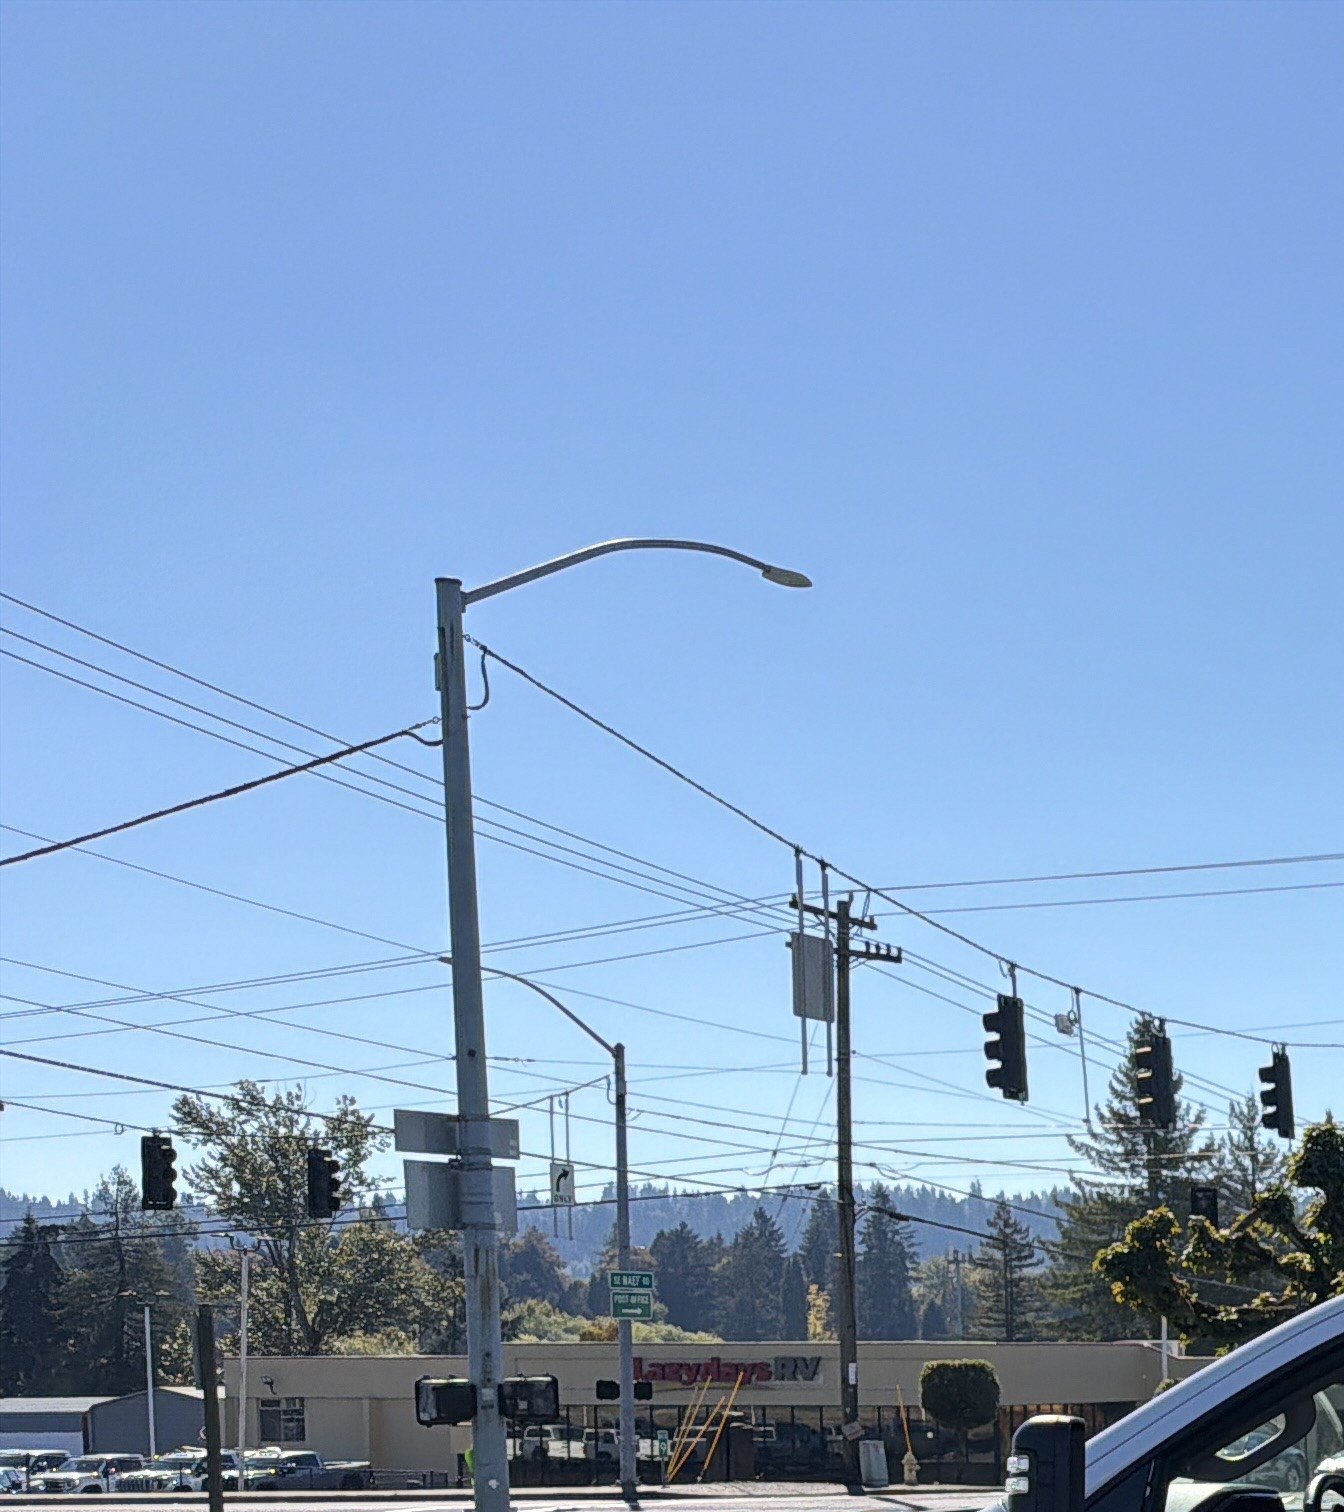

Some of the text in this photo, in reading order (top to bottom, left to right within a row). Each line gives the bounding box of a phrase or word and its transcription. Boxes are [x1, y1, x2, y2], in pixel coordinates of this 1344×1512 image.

[554, 1194, 572, 1203] ONLY
[614, 1295, 649, 1304] POST OFFICE
[632, 1356, 822, 1385] Lazydays RV
